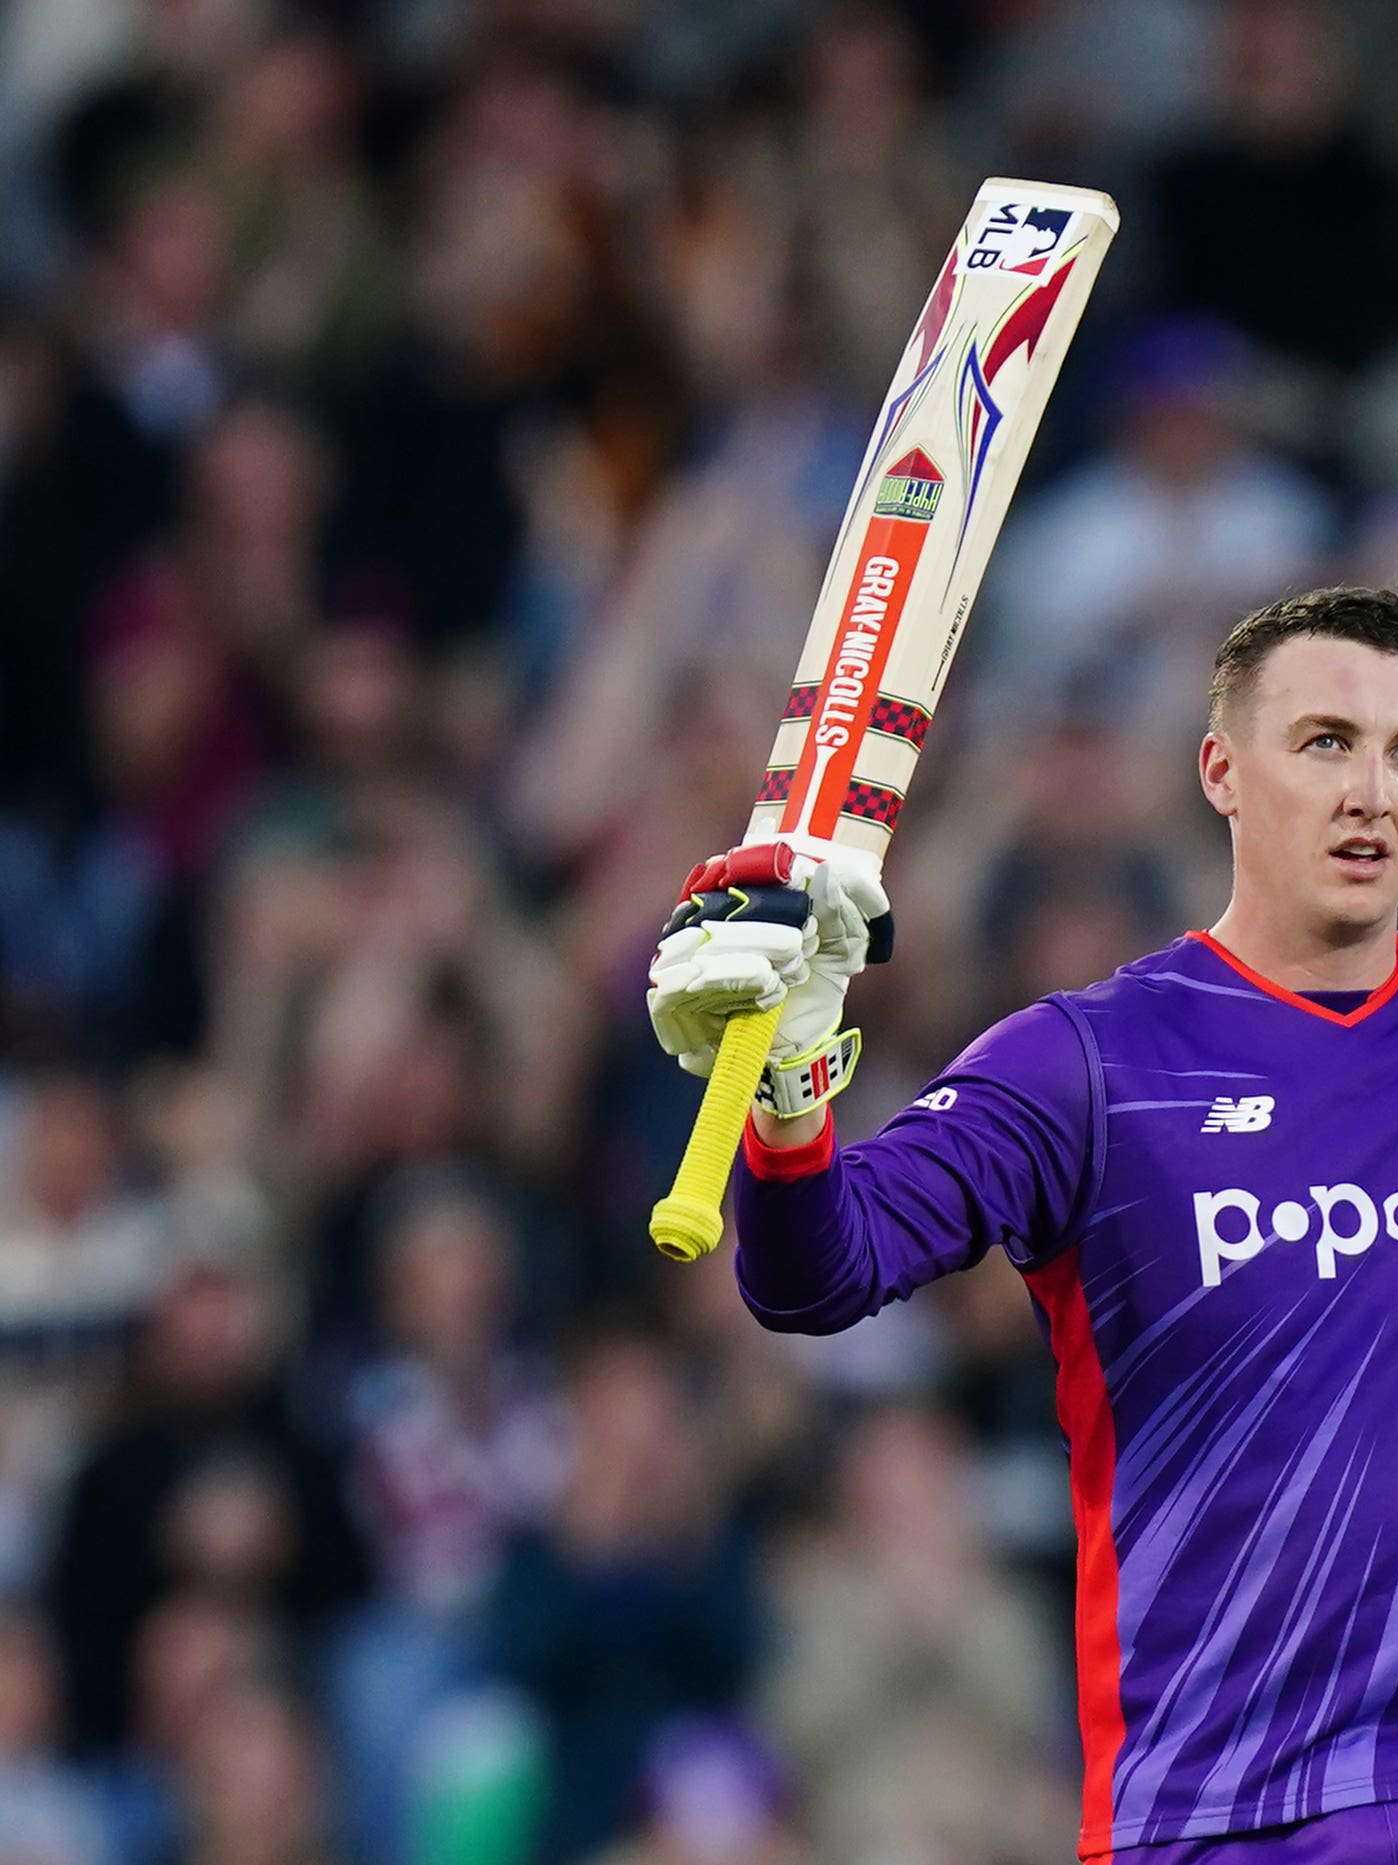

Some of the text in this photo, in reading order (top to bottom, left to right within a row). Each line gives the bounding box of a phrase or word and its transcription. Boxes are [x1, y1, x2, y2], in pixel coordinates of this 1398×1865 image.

[967, 204, 1019, 268] MLB
[815, 555, 899, 746] GRAY-NICOLLS
[1200, 1096, 1275, 1133] NB
